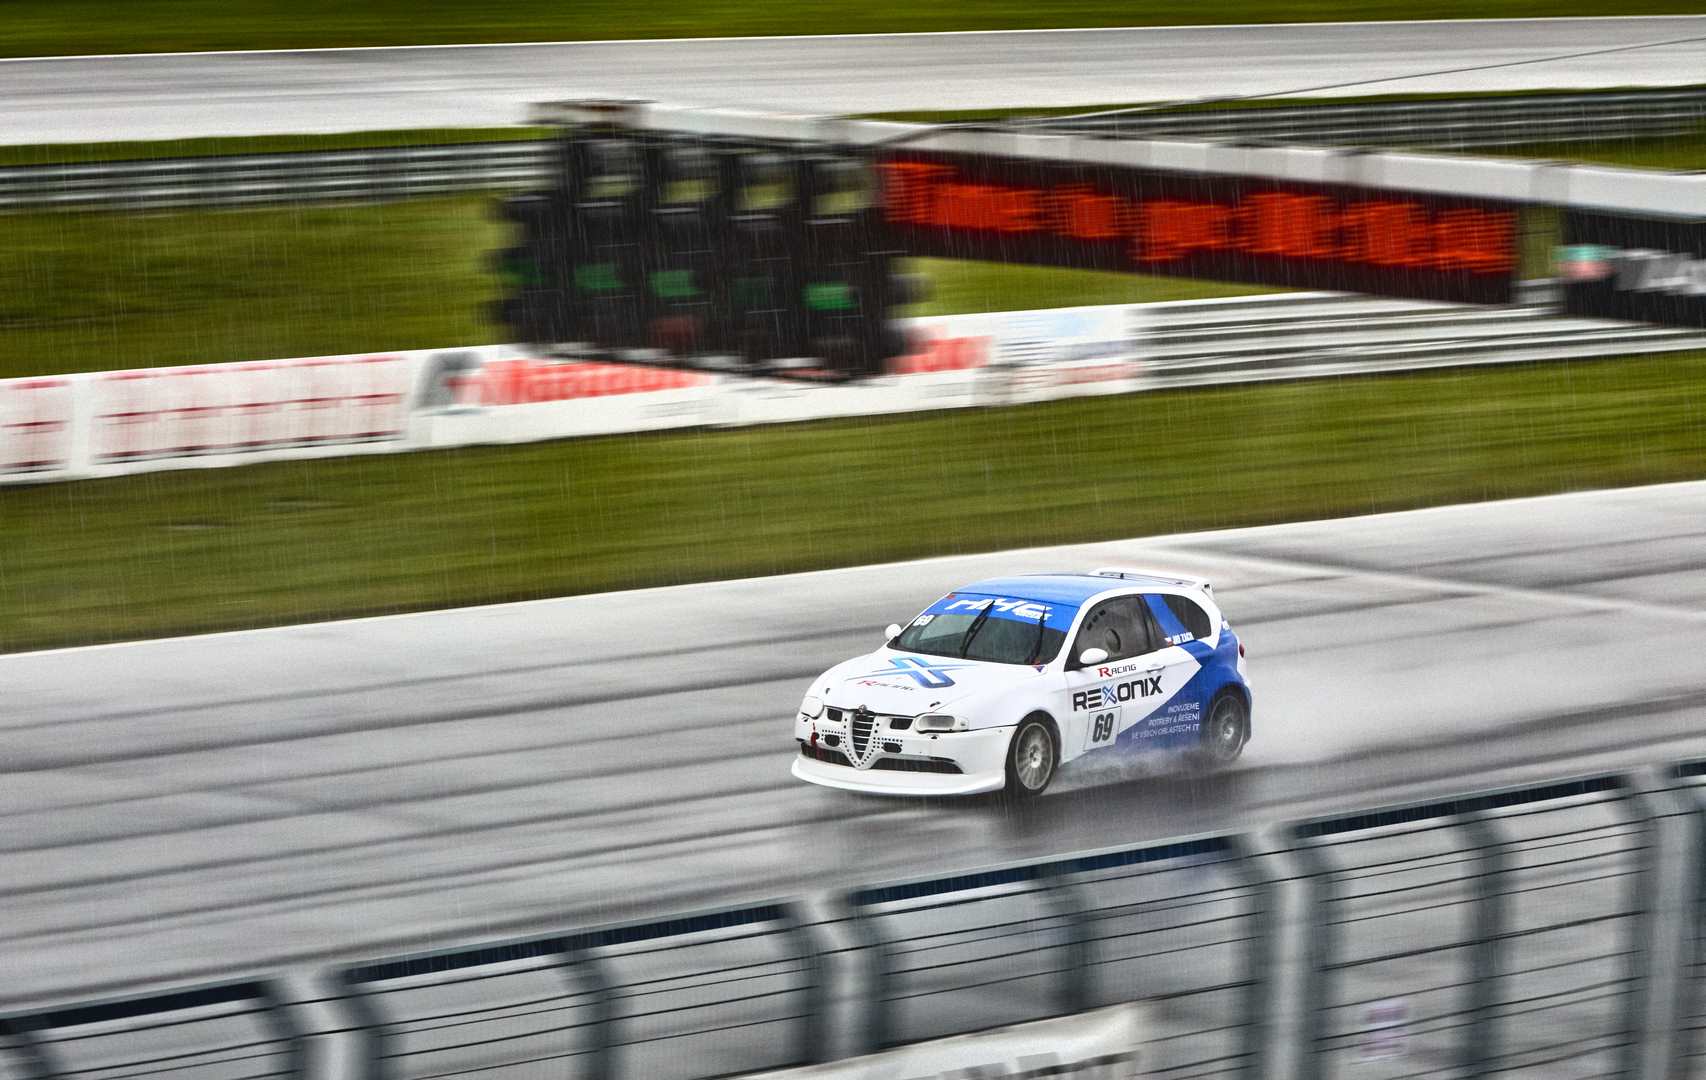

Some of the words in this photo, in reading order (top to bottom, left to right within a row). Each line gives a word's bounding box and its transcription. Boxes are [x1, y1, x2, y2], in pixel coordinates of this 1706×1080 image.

[1097, 663, 1136, 677] RACING
[1073, 675, 1163, 712] REXONIX
[1092, 713, 1114, 743] 69
